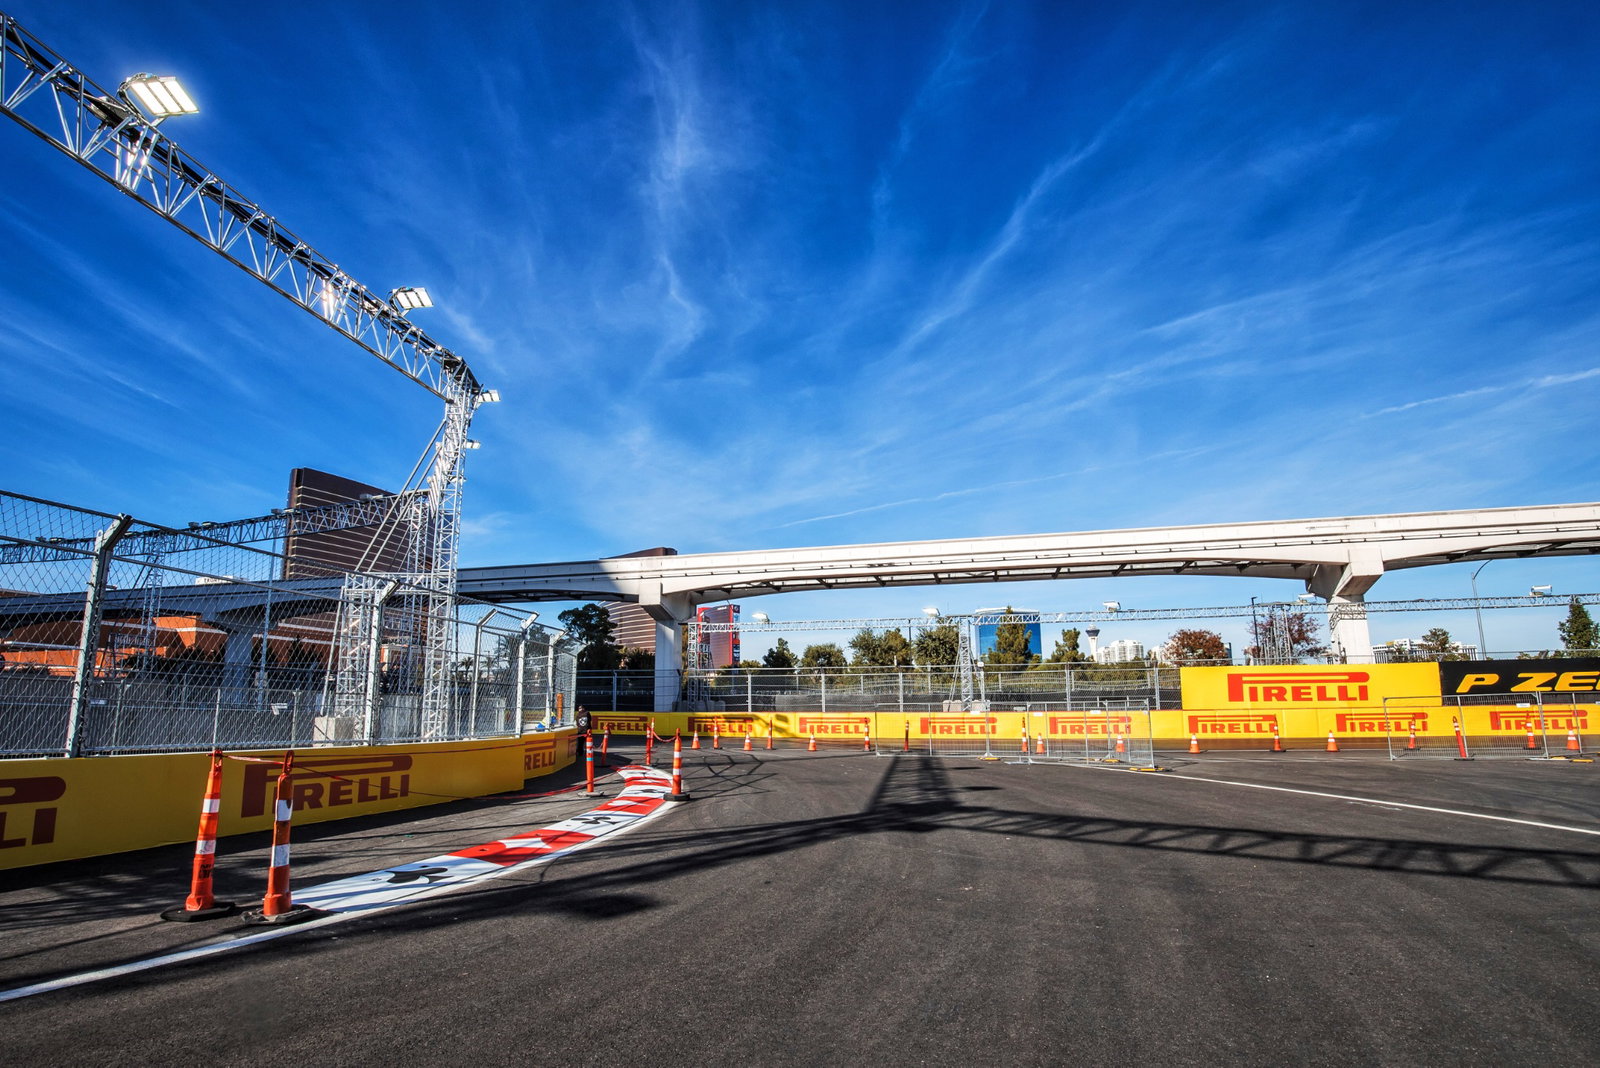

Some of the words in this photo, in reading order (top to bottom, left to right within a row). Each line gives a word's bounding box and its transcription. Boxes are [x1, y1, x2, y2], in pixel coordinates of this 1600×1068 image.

[1227, 671, 1370, 702] PIRELLI
[1456, 673, 1499, 693] P
[1510, 671, 1600, 692] ZE
[688, 716, 754, 733] PIRELLI
[799, 717, 871, 734] PIRELL
[920, 717, 997, 734] PIRELLI
[1049, 716, 1132, 734] PIRELLI
[1336, 712, 1429, 732] PIRELLI
[1490, 709, 1588, 731] PIRELLI
[525, 738, 557, 771] RELLI
